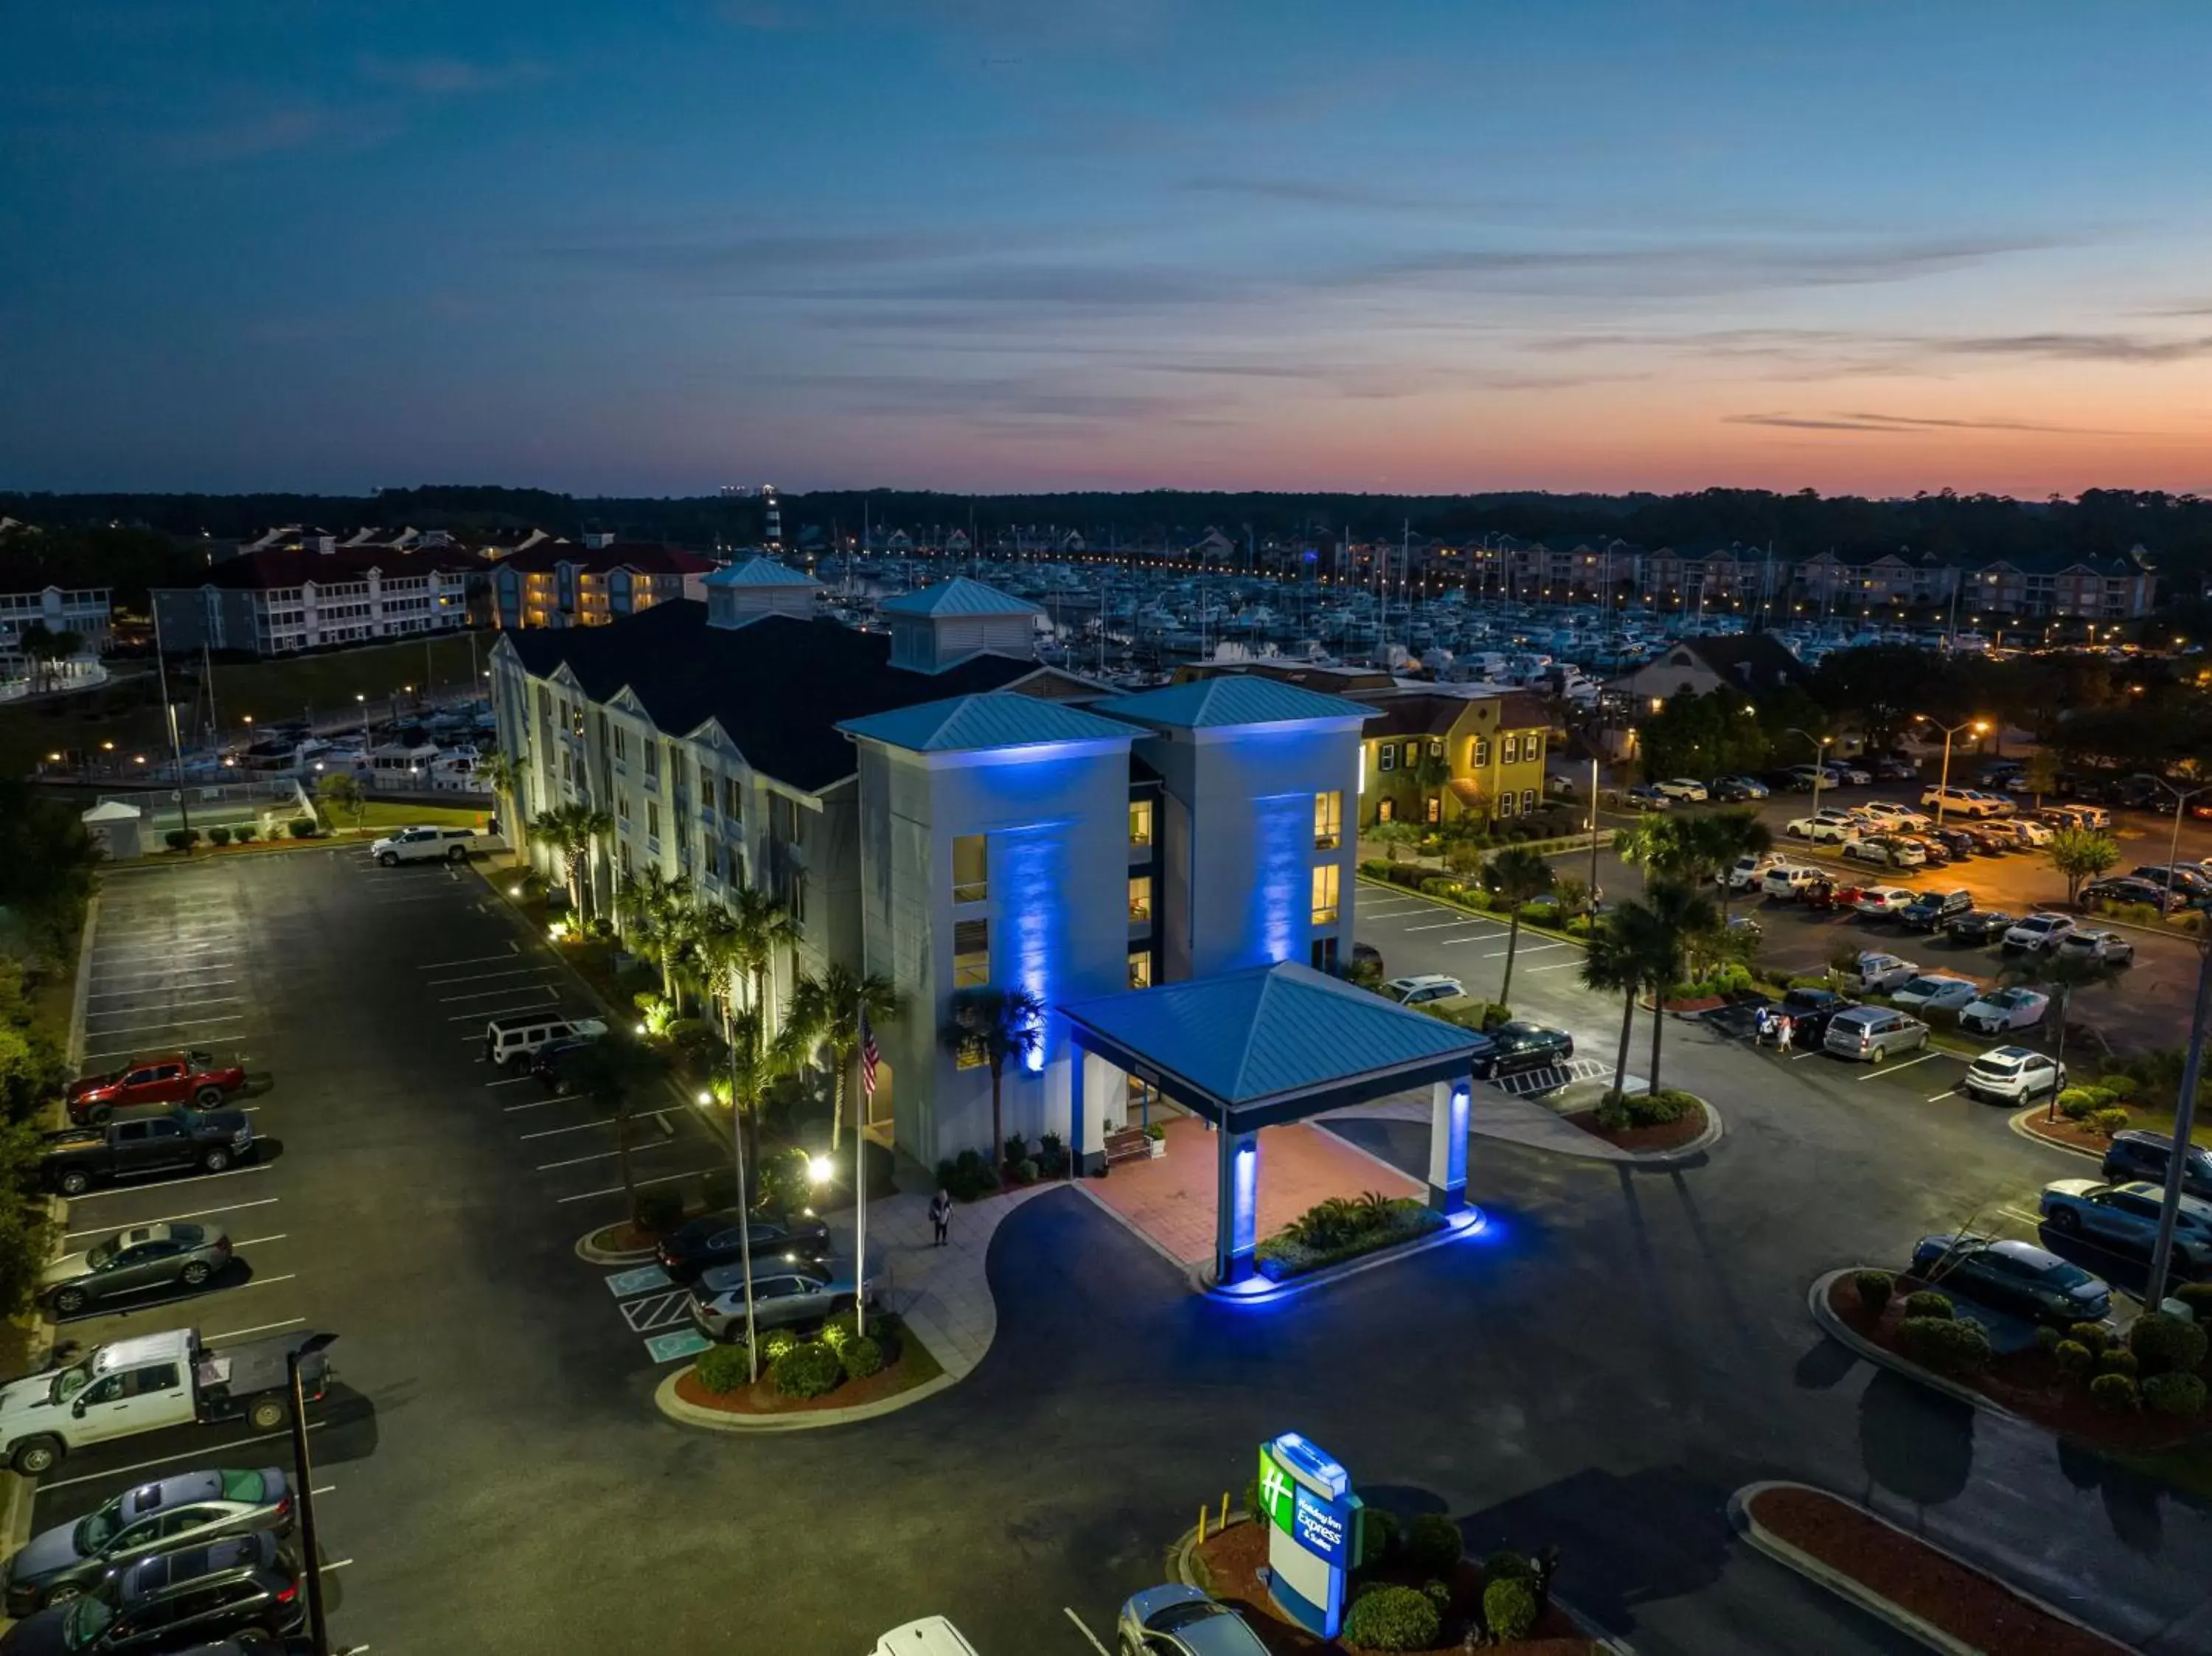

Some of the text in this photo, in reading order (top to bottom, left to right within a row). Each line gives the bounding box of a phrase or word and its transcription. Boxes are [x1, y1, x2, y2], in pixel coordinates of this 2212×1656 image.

[1298, 1497, 1341, 1531] Holiday Inn
[1298, 1509, 1342, 1545] Express
[1310, 1533, 1332, 1552] Suites
